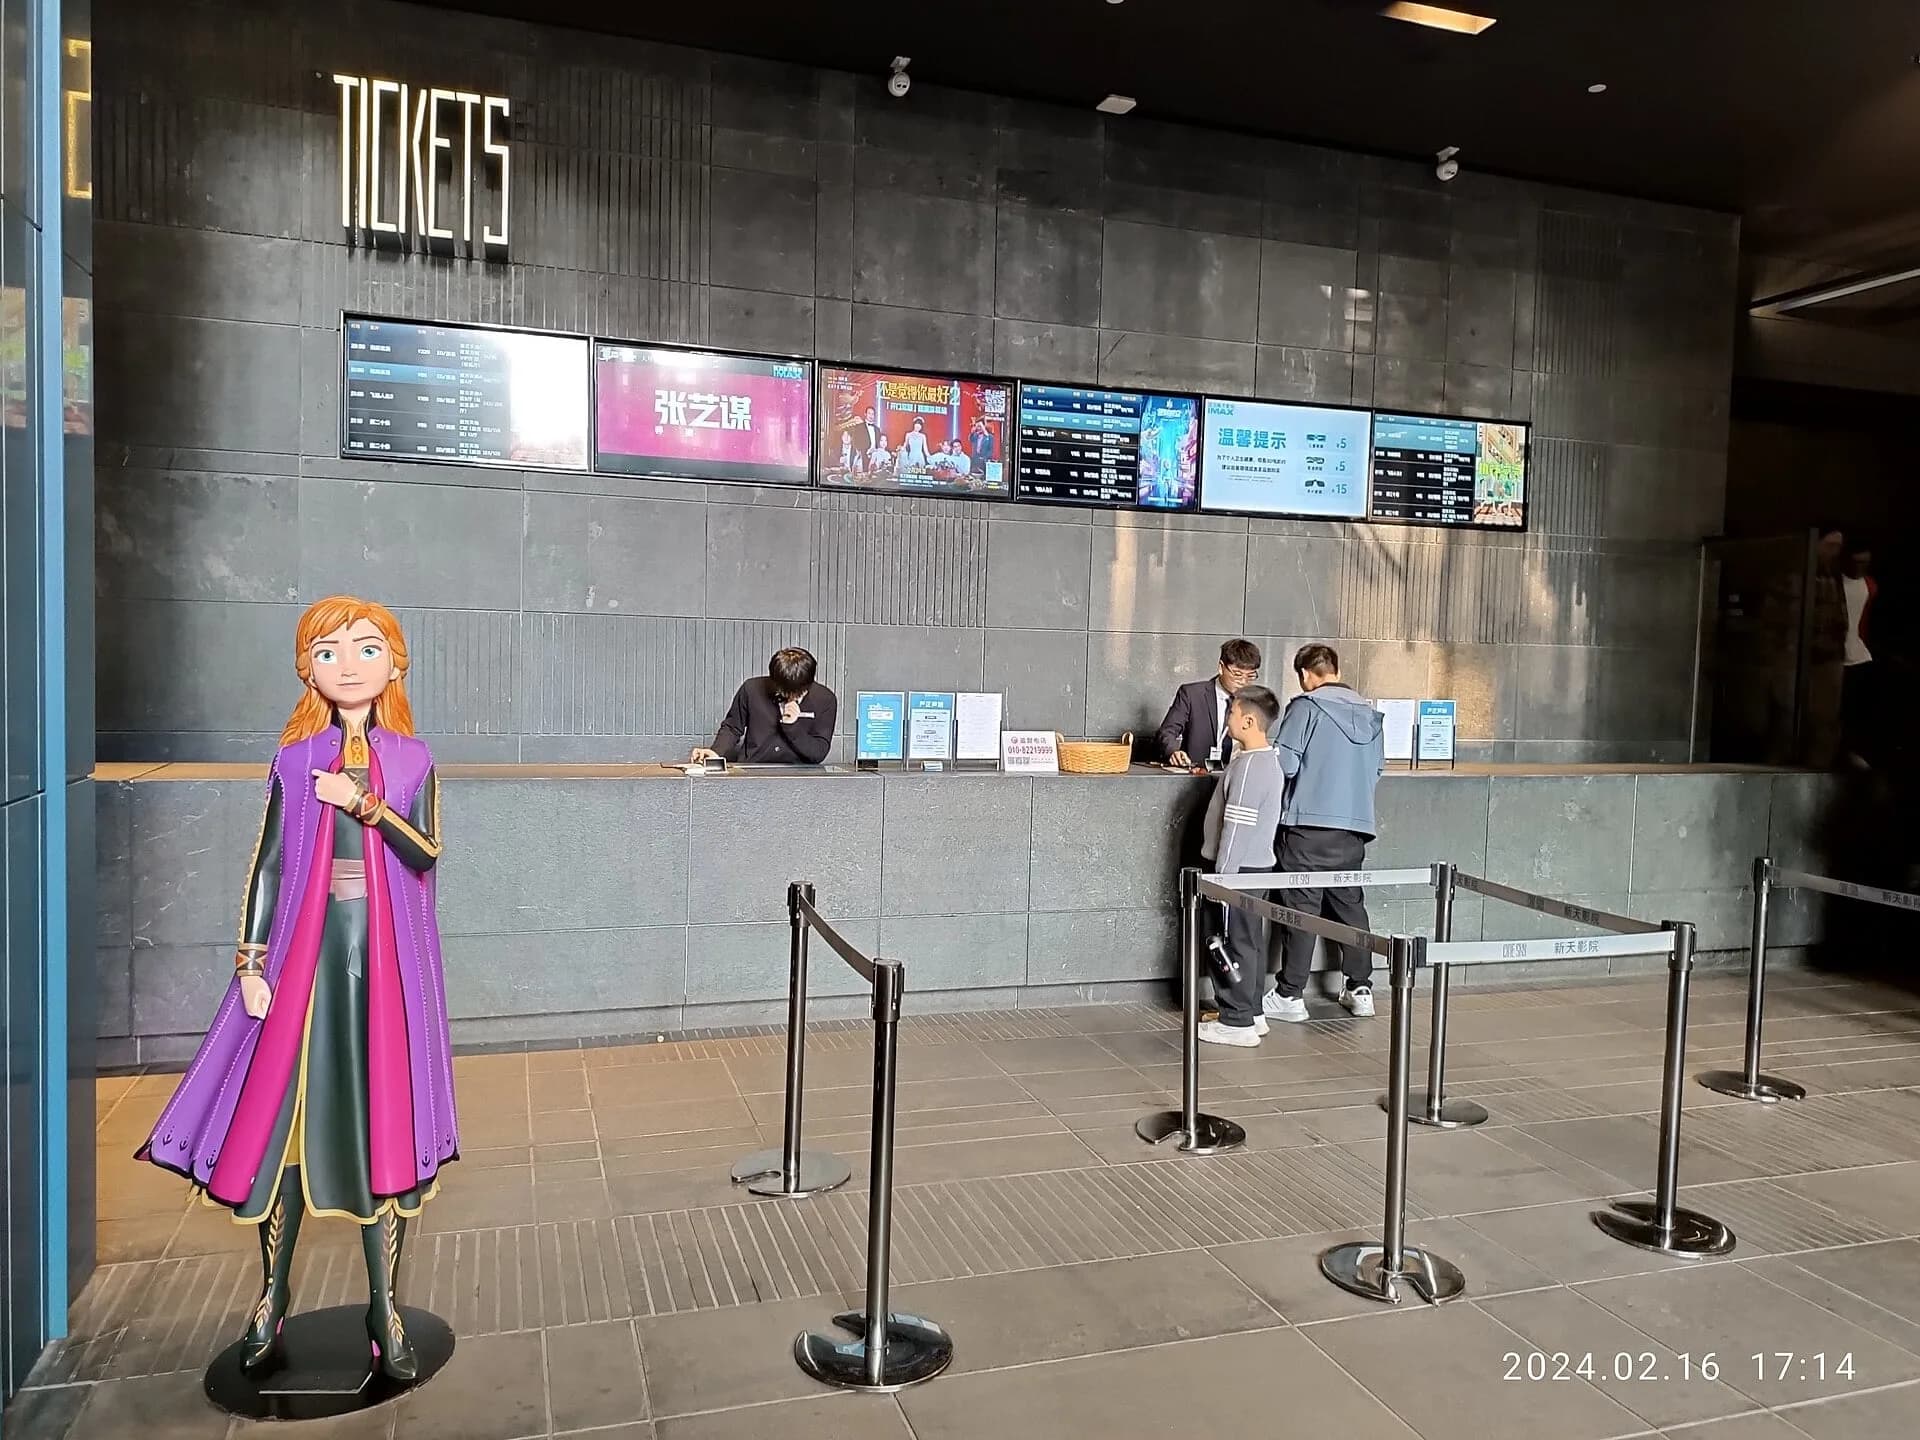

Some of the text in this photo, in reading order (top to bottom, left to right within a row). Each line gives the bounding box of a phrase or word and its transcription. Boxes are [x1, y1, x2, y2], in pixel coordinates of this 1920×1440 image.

[333, 74, 509, 246] TICKETS
[654, 389, 752, 431] 张艺谋
[1208, 407, 1234, 416] IMAX
[1218, 427, 1287, 449] 温馨提示
[1554, 940, 1599, 955] 新天影院
